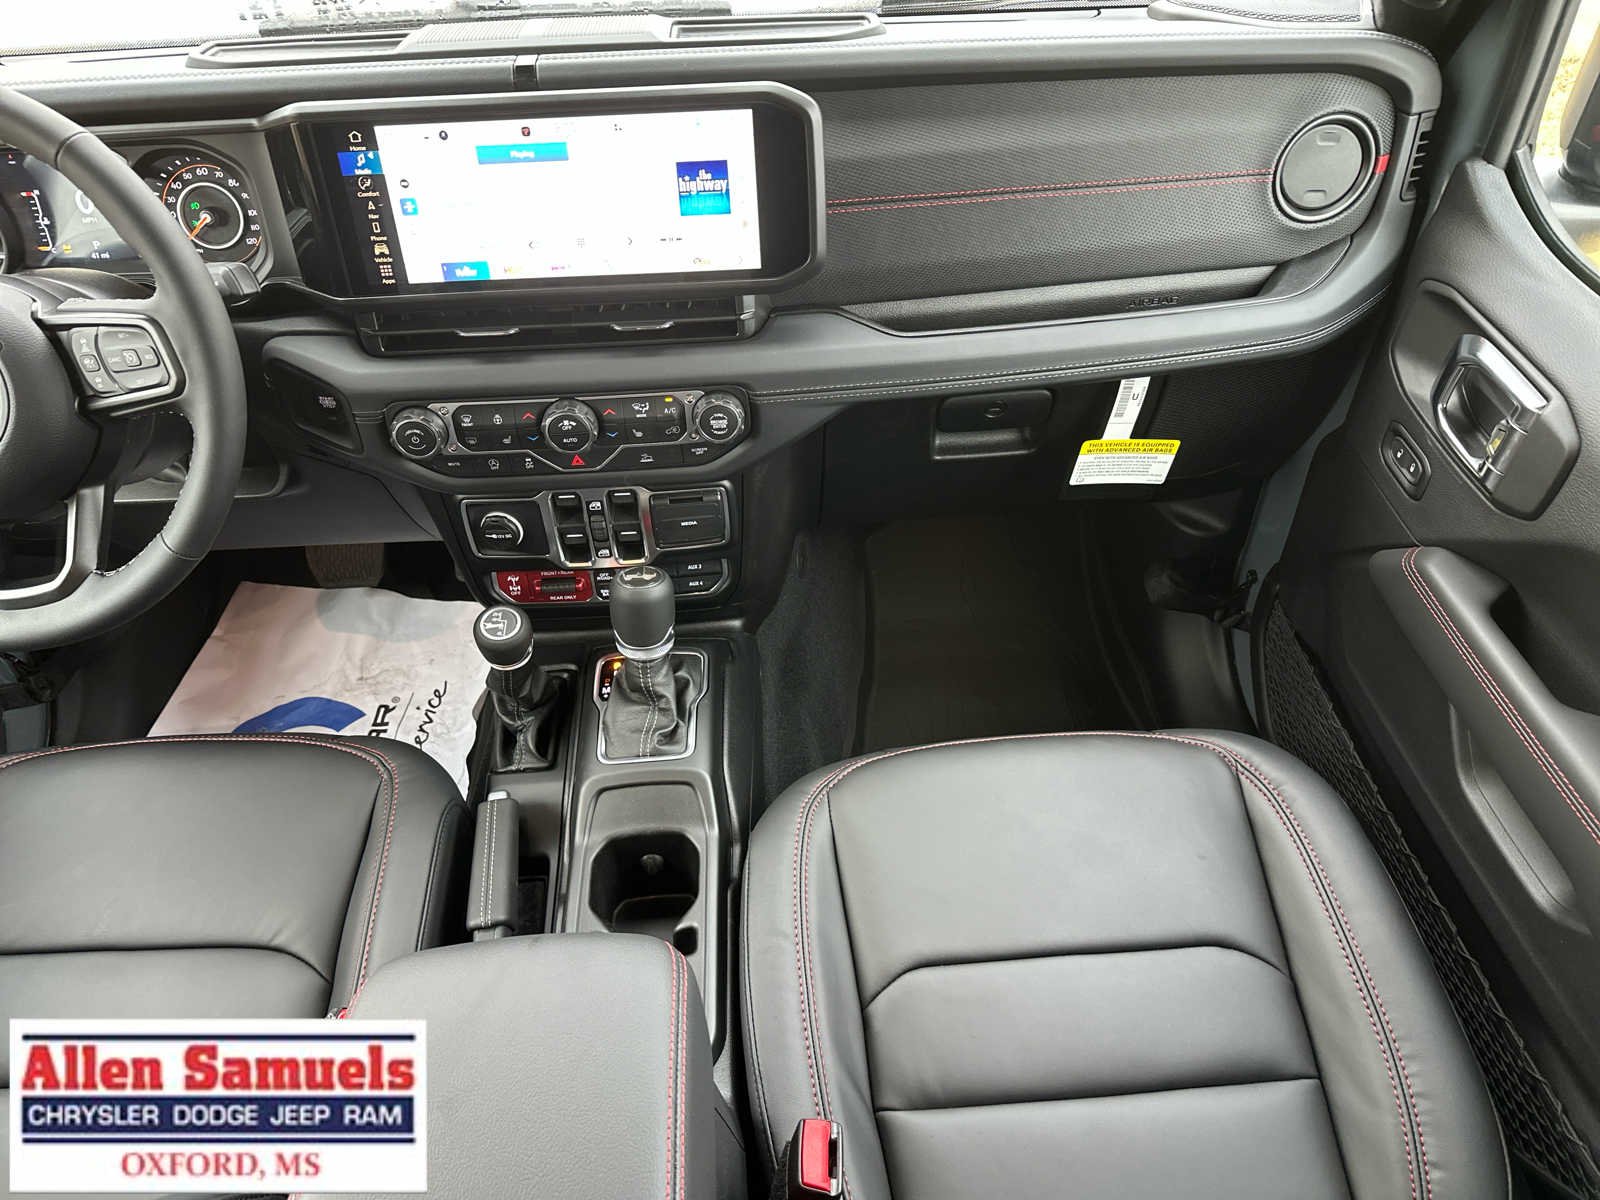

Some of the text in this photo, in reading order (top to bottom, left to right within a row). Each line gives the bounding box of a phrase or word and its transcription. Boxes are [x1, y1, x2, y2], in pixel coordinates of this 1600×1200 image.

[183, 172, 193, 180] 50
[196, 168, 208, 176] 60
[699, 169, 712, 180] the
[171, 181, 182, 190] 40
[678, 175, 728, 196] highway
[92, 240, 101, 250] P
[414, 680, 447, 750] ervice
